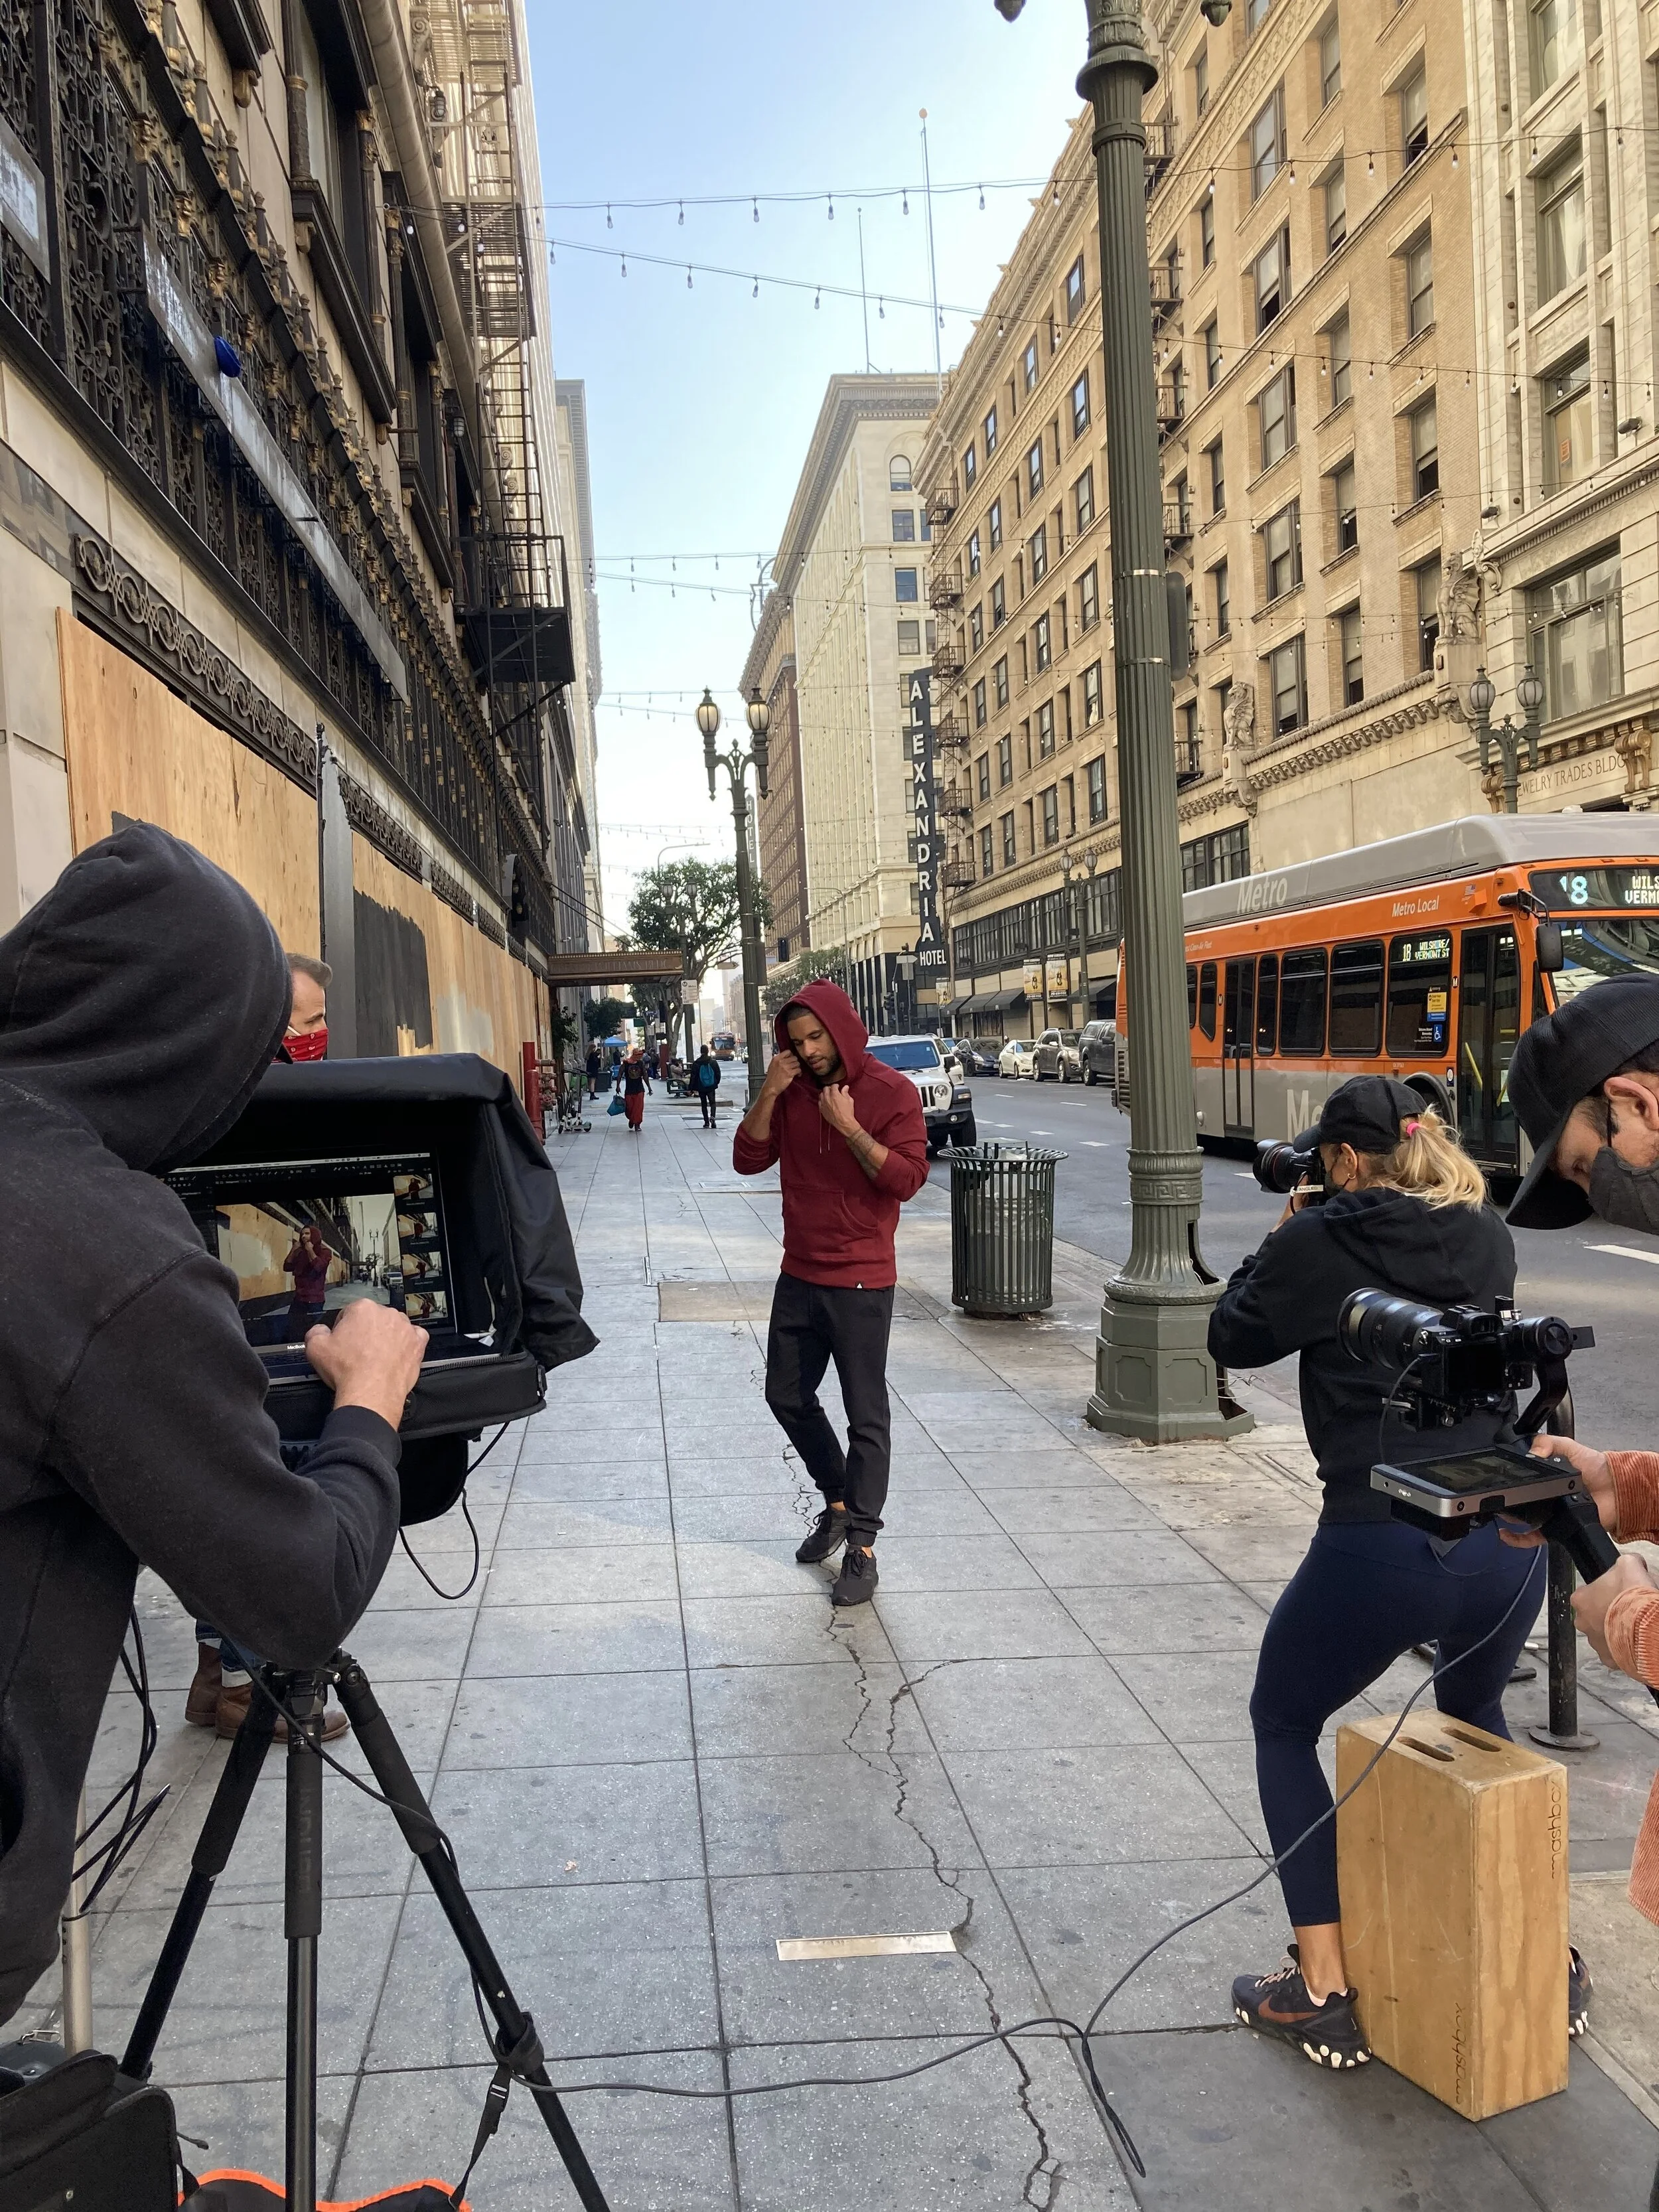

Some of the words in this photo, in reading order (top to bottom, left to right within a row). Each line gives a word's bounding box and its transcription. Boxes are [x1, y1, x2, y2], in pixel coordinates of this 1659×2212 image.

[1518, 774, 1553, 798] EWELRY
[1554, 761, 1593, 787] TRADES
[910, 680, 934, 942] ALEXANDRIA
[1237, 875, 1287, 914] Metro
[1392, 901, 1415, 917] Metro
[1417, 895, 1439, 913] Local
[919, 949, 947, 966] HOTEL
[1402, 943, 1412, 962] 18
[1419, 938, 1450, 951] WILSHIRE/
[1415, 948, 1441, 960] VERMONT
[1441, 948, 1450, 957] ST
